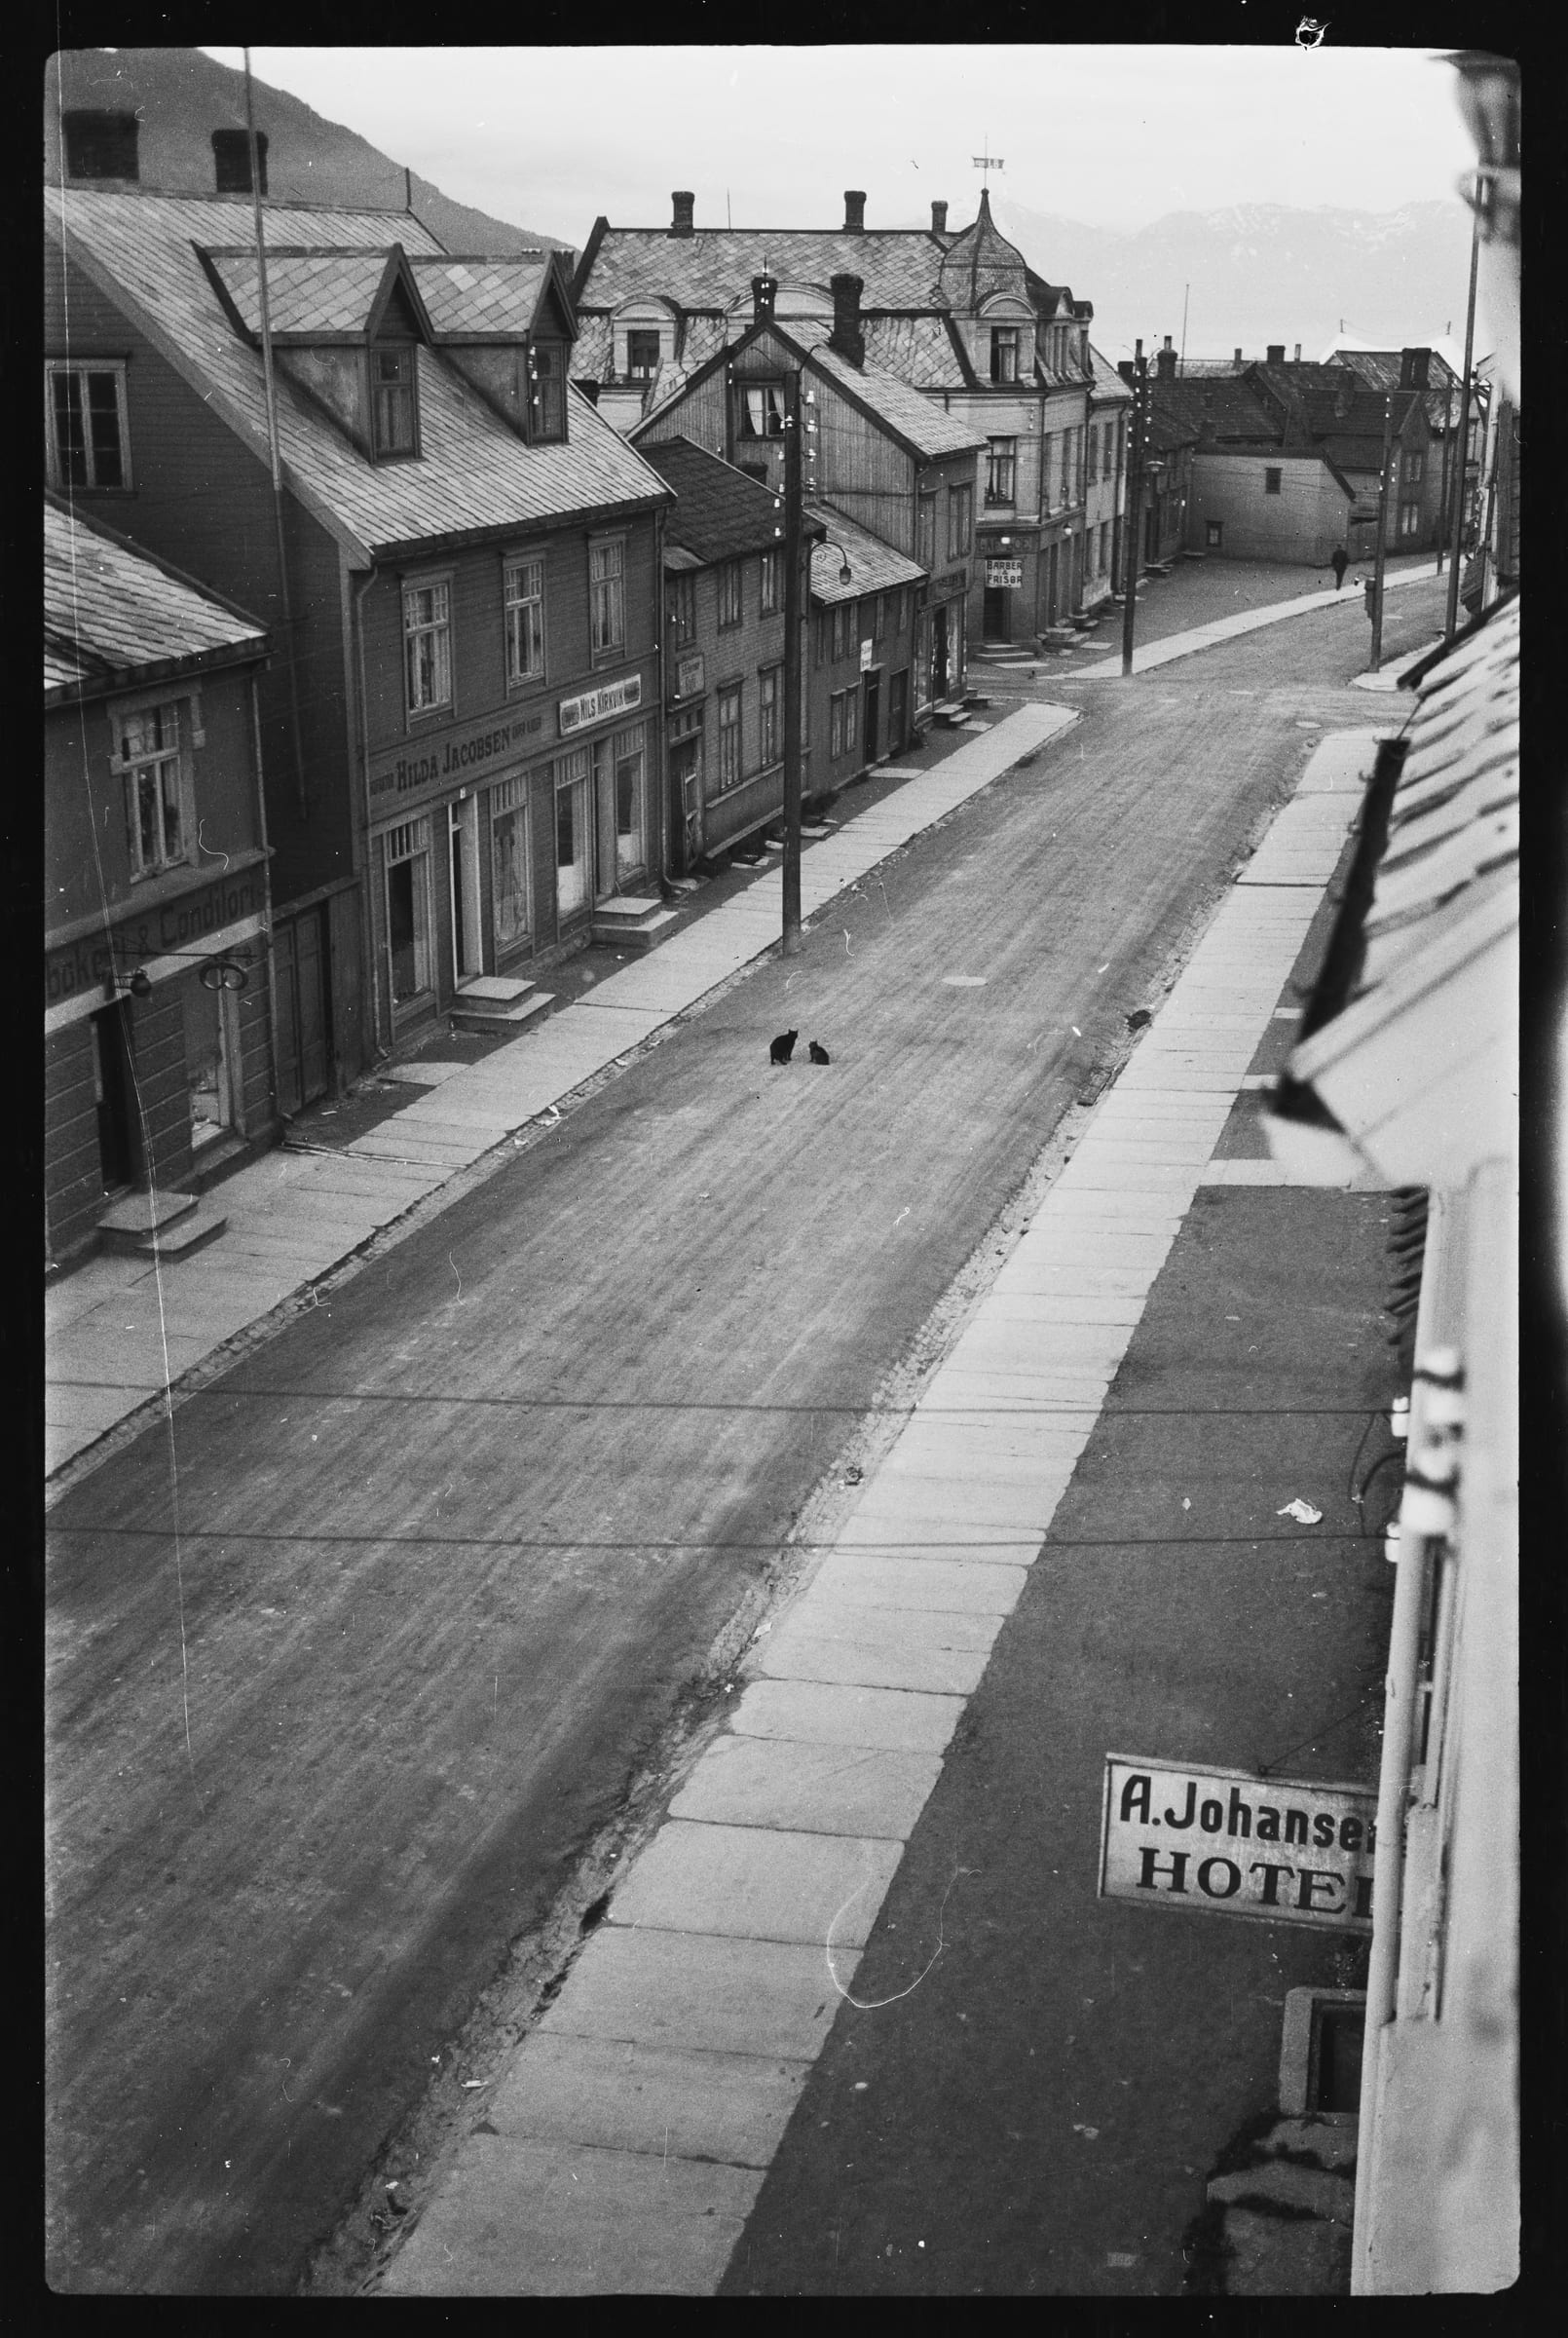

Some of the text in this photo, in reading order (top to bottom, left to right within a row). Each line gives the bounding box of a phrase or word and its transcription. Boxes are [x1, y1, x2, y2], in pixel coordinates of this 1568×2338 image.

[987, 560, 1023, 570] BARBER
[579, 697, 596, 722] NILS
[396, 755, 439, 793] HILDA
[442, 725, 511, 774] JACOBSEN
